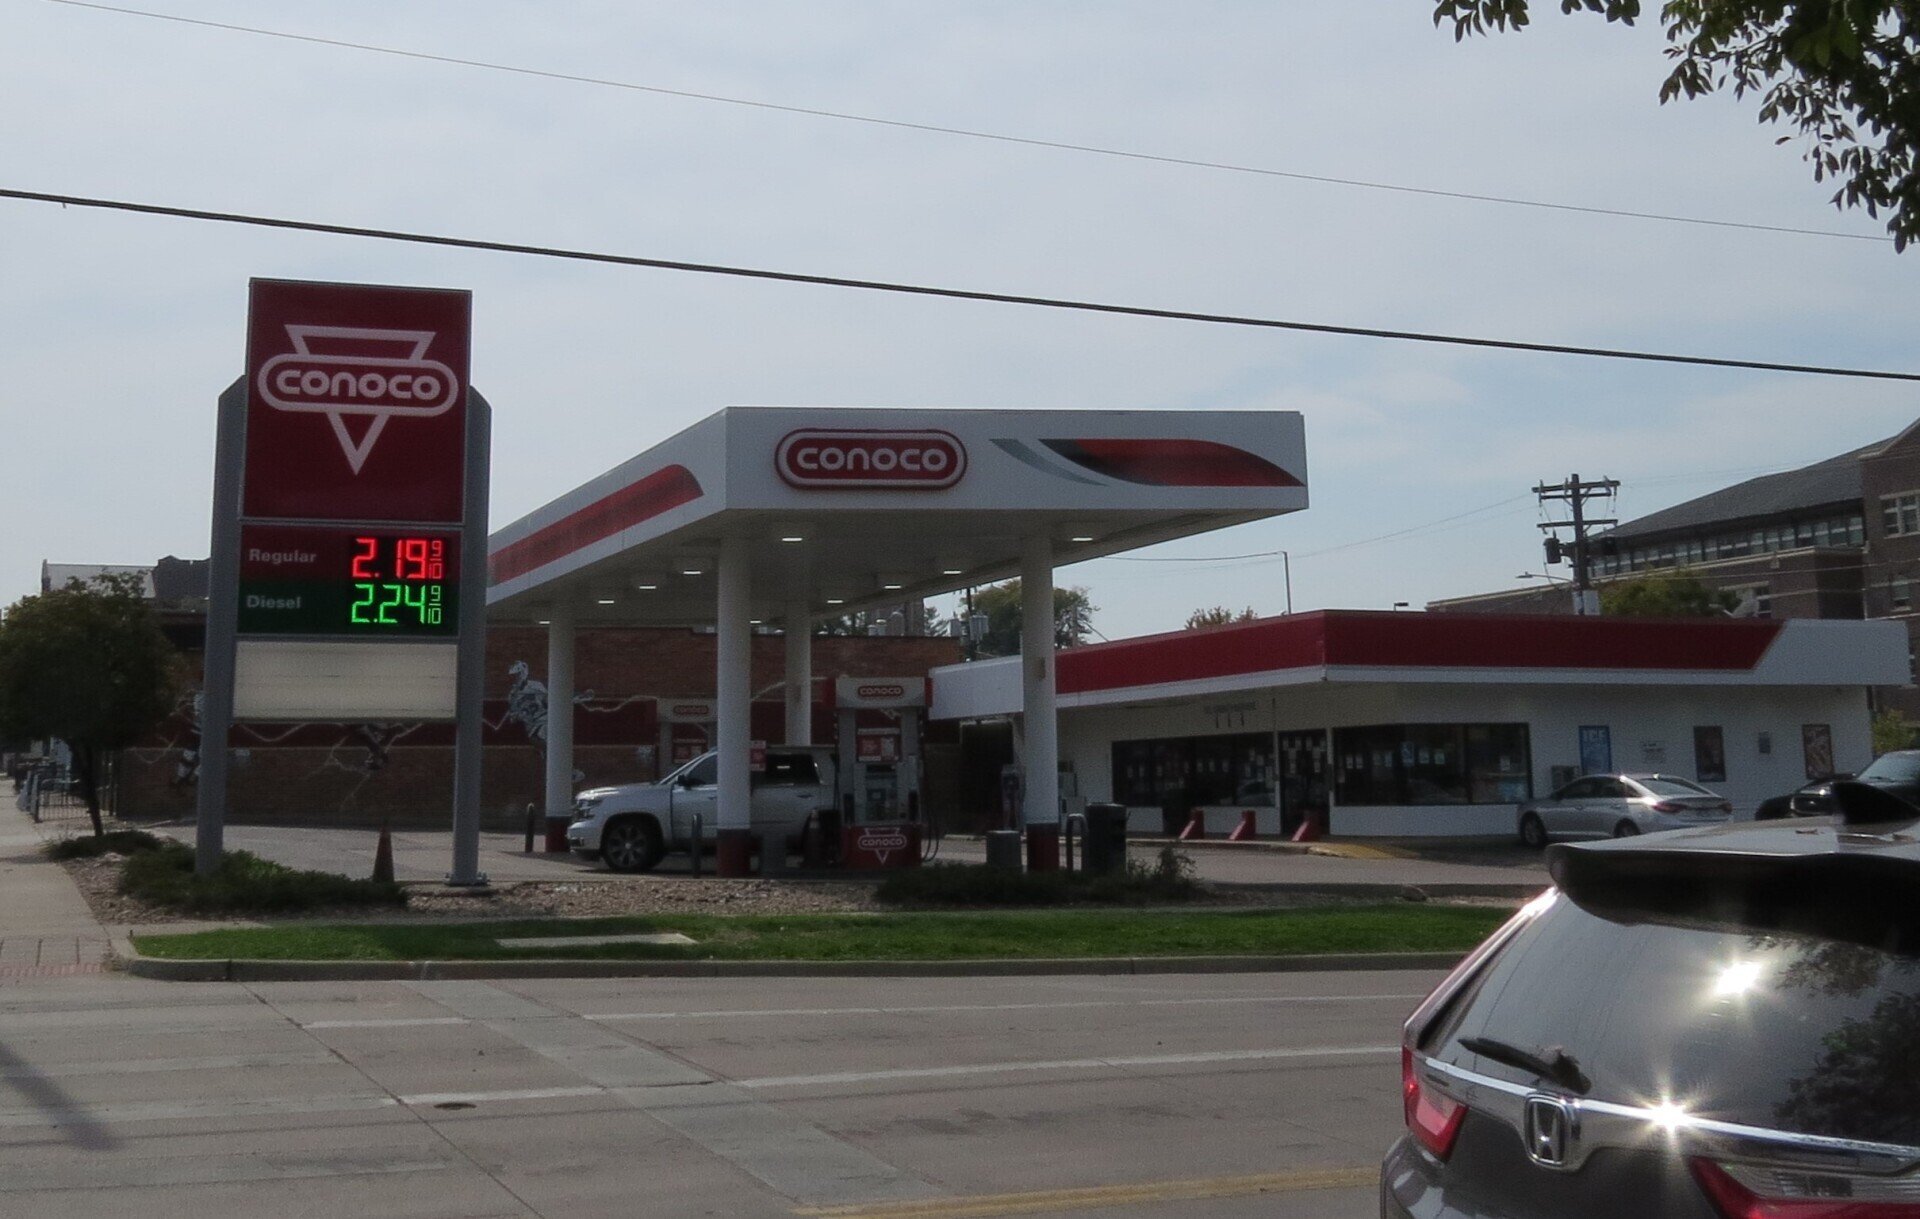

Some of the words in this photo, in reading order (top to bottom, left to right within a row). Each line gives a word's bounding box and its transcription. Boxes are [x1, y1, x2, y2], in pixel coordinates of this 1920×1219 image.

[249, 549, 317, 565] Regular
[246, 595, 301, 609] Diesel
[351, 583, 426, 624] 2.24
